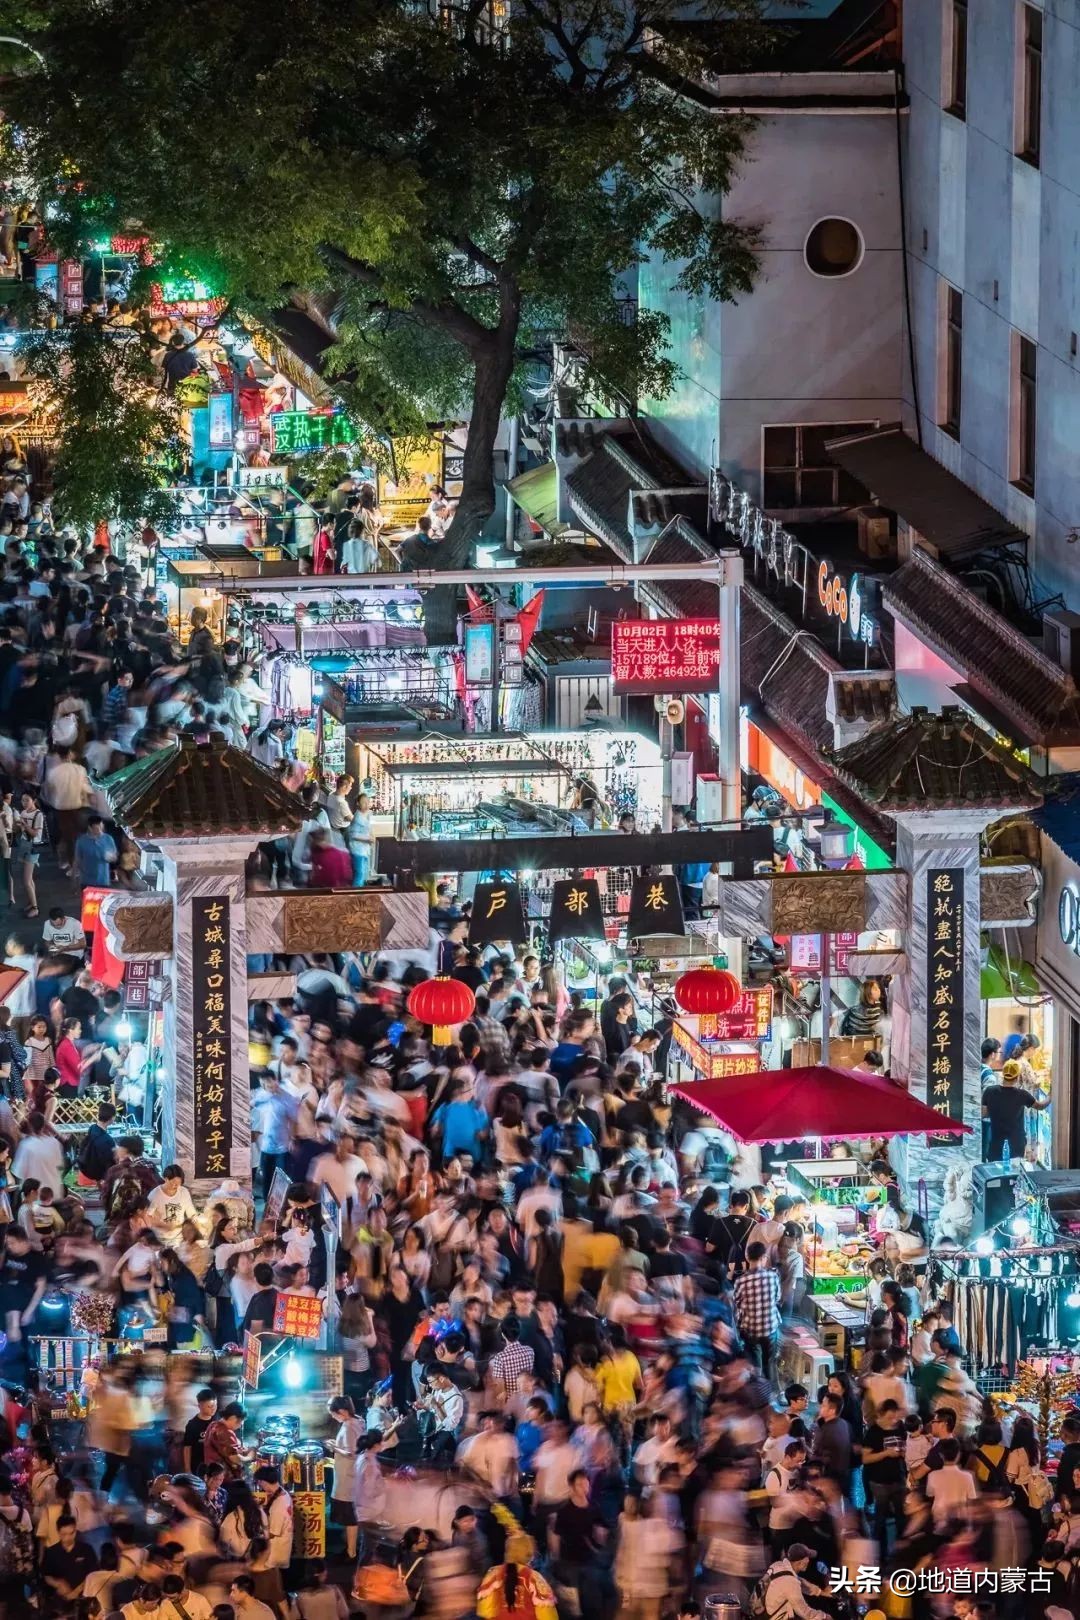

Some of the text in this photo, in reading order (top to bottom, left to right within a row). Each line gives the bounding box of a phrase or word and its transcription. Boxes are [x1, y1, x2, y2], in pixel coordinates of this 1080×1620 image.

[818, 561, 848, 624] CoCo
[617, 626, 666, 637] 10月02日
[711, 1058, 757, 1077] 照片秒洗
